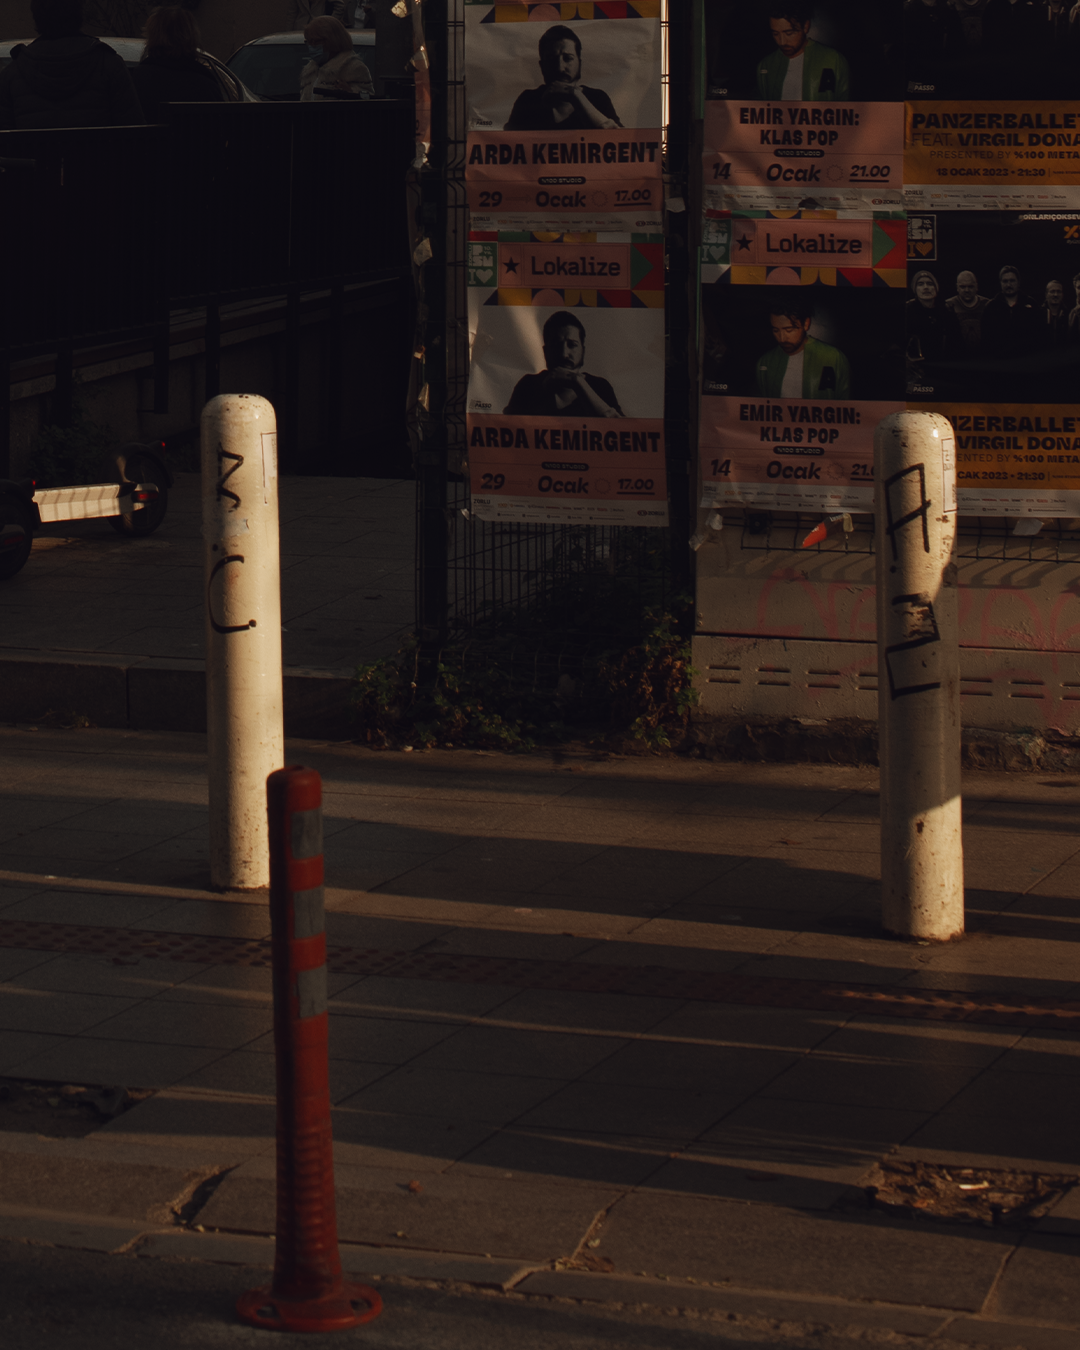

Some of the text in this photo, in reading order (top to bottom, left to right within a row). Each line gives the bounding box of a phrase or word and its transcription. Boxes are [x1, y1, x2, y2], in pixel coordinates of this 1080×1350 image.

[740, 103, 860, 126] EMİR YARGIN:
[912, 113, 1080, 129] PANZERBALLE
[760, 129, 838, 146] KLAS POP
[912, 133, 952, 146] FEAT.
[957, 133, 1024, 147] VIRGIL
[469, 137, 658, 165] ARDA KEMİRGENT
[930, 150, 993, 159] PRESENTED
[997, 151, 1011, 159] BY
[1014, 151, 1044, 159] %100
[712, 162, 890, 181] 14 Ocak 21.00
[936, 168, 1008, 177] 18 OCAK 2023
[1017, 168, 1045, 177] 21:30
[478, 189, 651, 208] 29 Ocak 17.00
[765, 233, 863, 254] Lokalize
[531, 256, 621, 276] Lokalize
[739, 400, 861, 424] EMİR YARGIN:
[470, 424, 660, 452] ARDA KEMİRGENT
[760, 426, 839, 444] KLAS POP
[956, 436, 1023, 450] VIRGIL
[956, 454, 993, 462] ENTED
[997, 454, 1010, 462] BY
[1013, 455, 1044, 463] %100
[710, 459, 731, 476] 14
[766, 460, 820, 479] Ocak
[957, 471, 1008, 480] CAK 2023
[1017, 472, 1045, 480] 21:30
[480, 473, 654, 495] 29 Ocak 17.00
